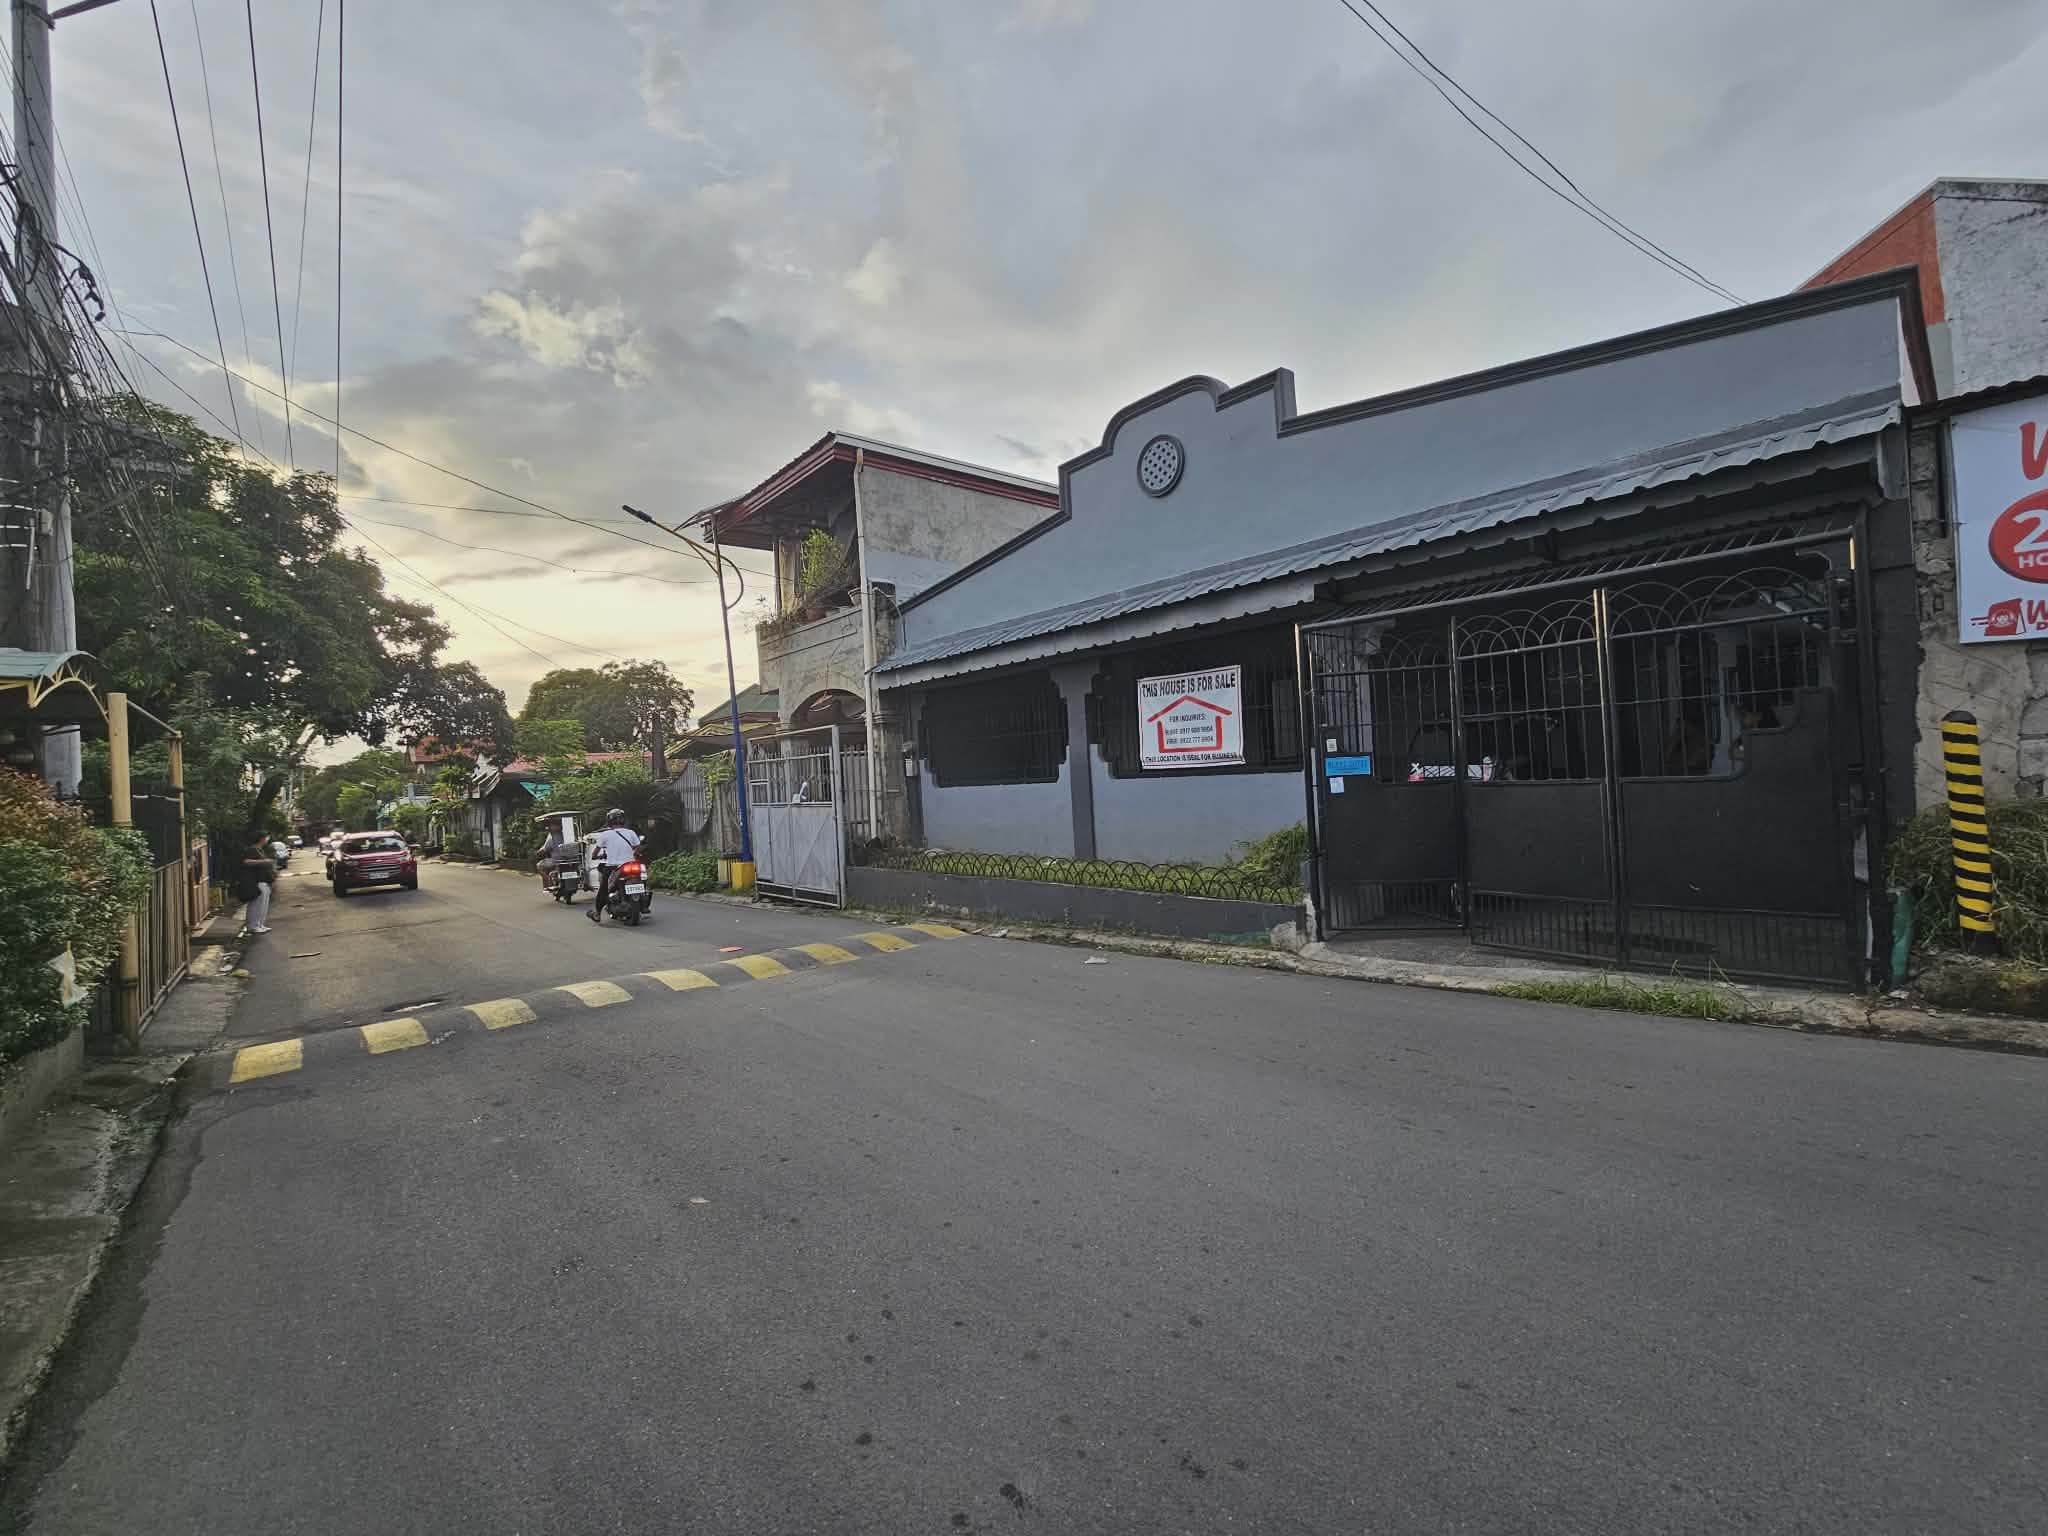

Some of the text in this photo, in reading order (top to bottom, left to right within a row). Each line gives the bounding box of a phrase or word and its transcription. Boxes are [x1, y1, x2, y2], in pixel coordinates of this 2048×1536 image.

[1142, 673, 1235, 698] THIS HOUSE IS FOR SALE
[1157, 754, 1180, 762] LOCATION
[1201, 752, 1211, 760] FOR
